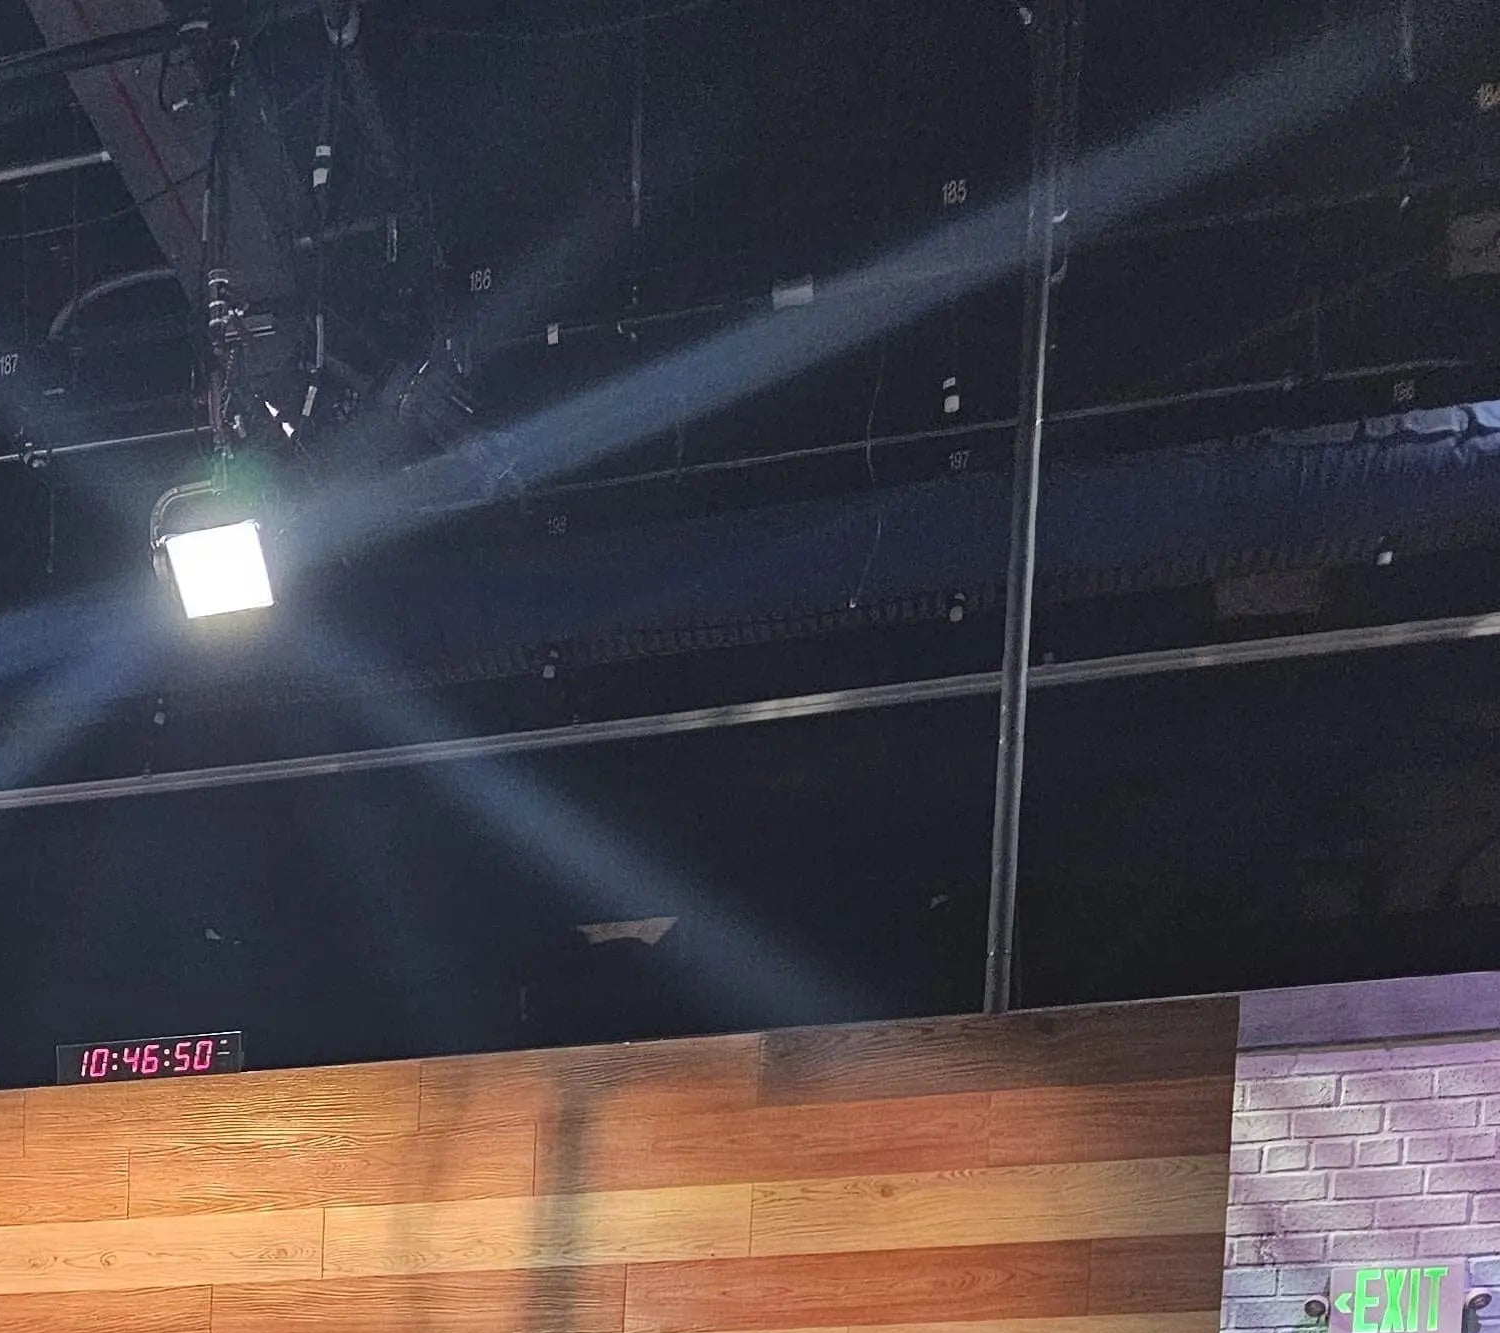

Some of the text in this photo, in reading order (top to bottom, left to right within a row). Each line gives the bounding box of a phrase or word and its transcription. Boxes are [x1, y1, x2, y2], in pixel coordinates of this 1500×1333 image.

[0, 353, 18, 375] 187
[81, 1039, 213, 1077] 10:46:50
[1352, 1266, 1448, 1333] EXIT
